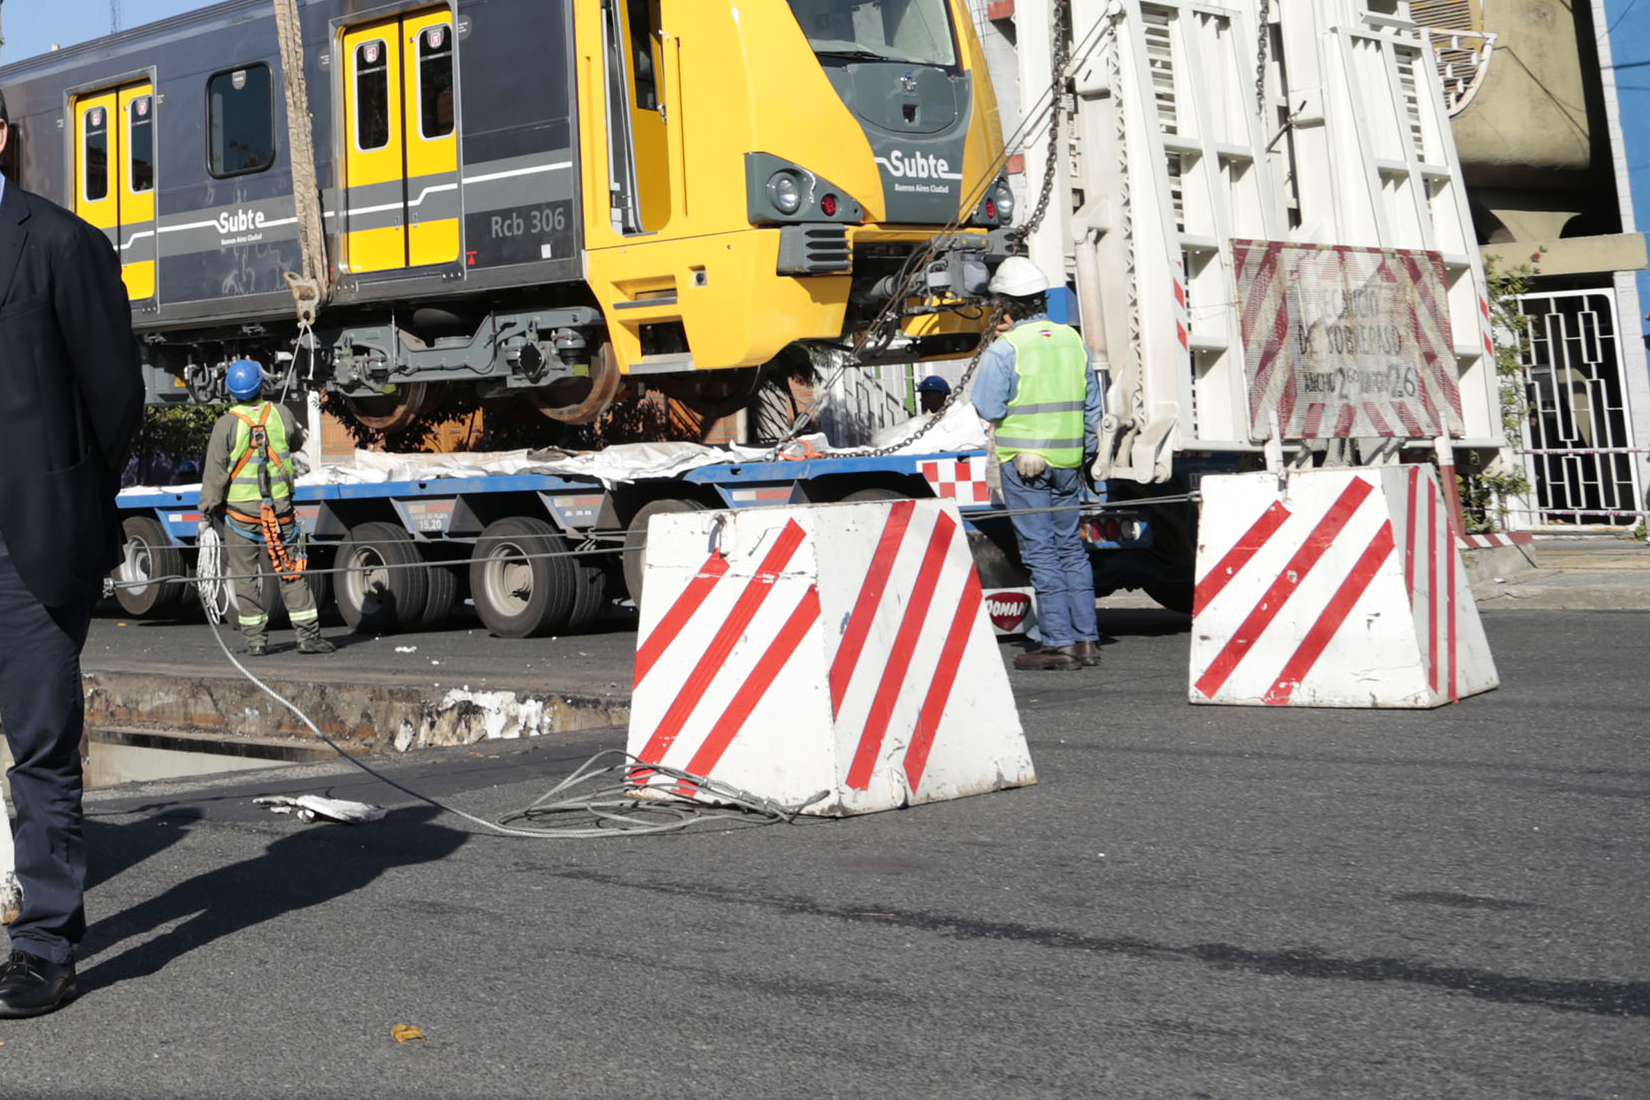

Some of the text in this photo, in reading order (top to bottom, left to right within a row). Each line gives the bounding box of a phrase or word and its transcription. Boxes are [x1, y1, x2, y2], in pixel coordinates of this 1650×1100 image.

[888, 149, 950, 180] Subte
[217, 208, 266, 234] Subte
[491, 207, 565, 239] Rcb 306
